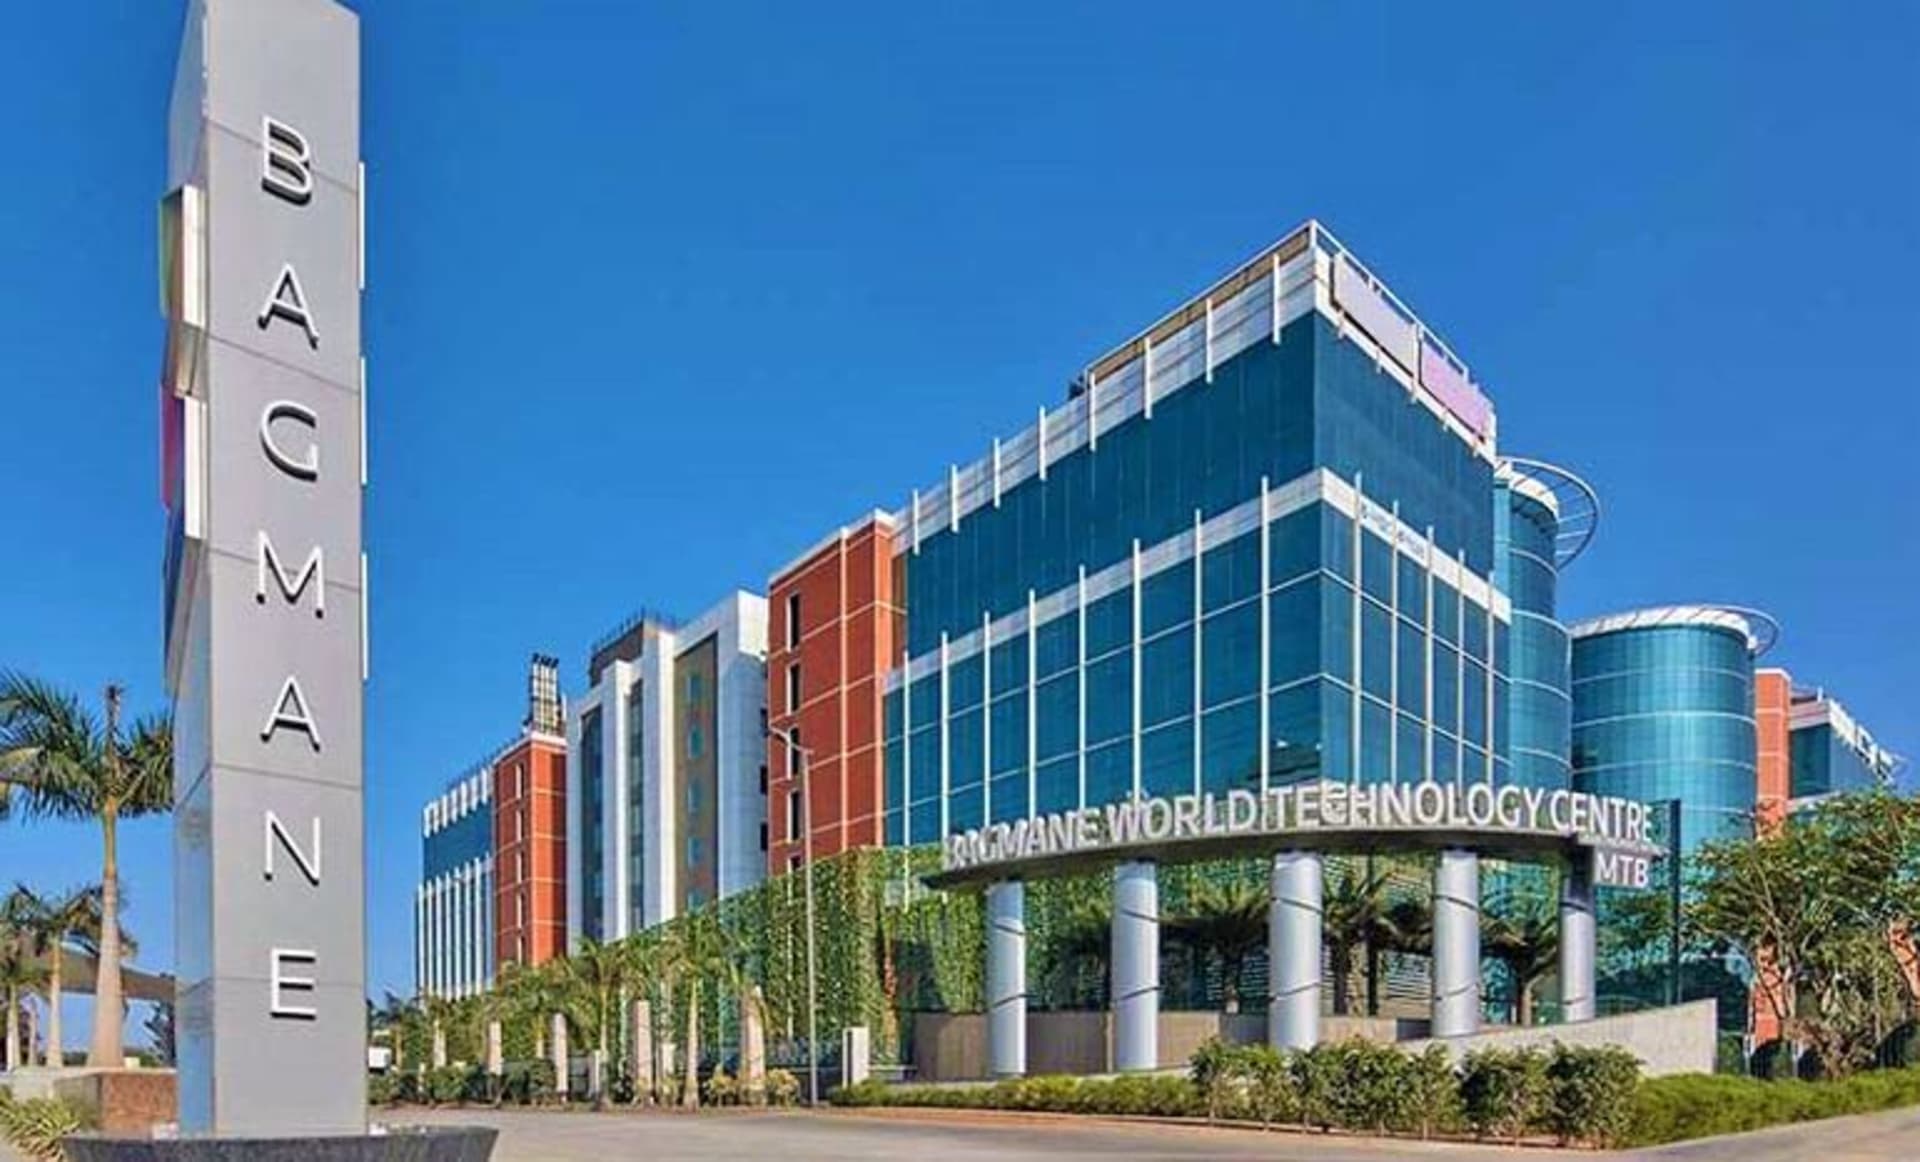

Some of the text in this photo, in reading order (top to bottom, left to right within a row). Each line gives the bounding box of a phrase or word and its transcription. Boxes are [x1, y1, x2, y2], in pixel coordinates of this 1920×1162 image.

[258, 115, 325, 1020] BAGMANE
[1106, 788, 1257, 844] WORLD
[1266, 781, 1545, 832] TECHNOLOGY
[1550, 789, 1653, 844] CENTRE
[1596, 852, 1649, 888] MTB
